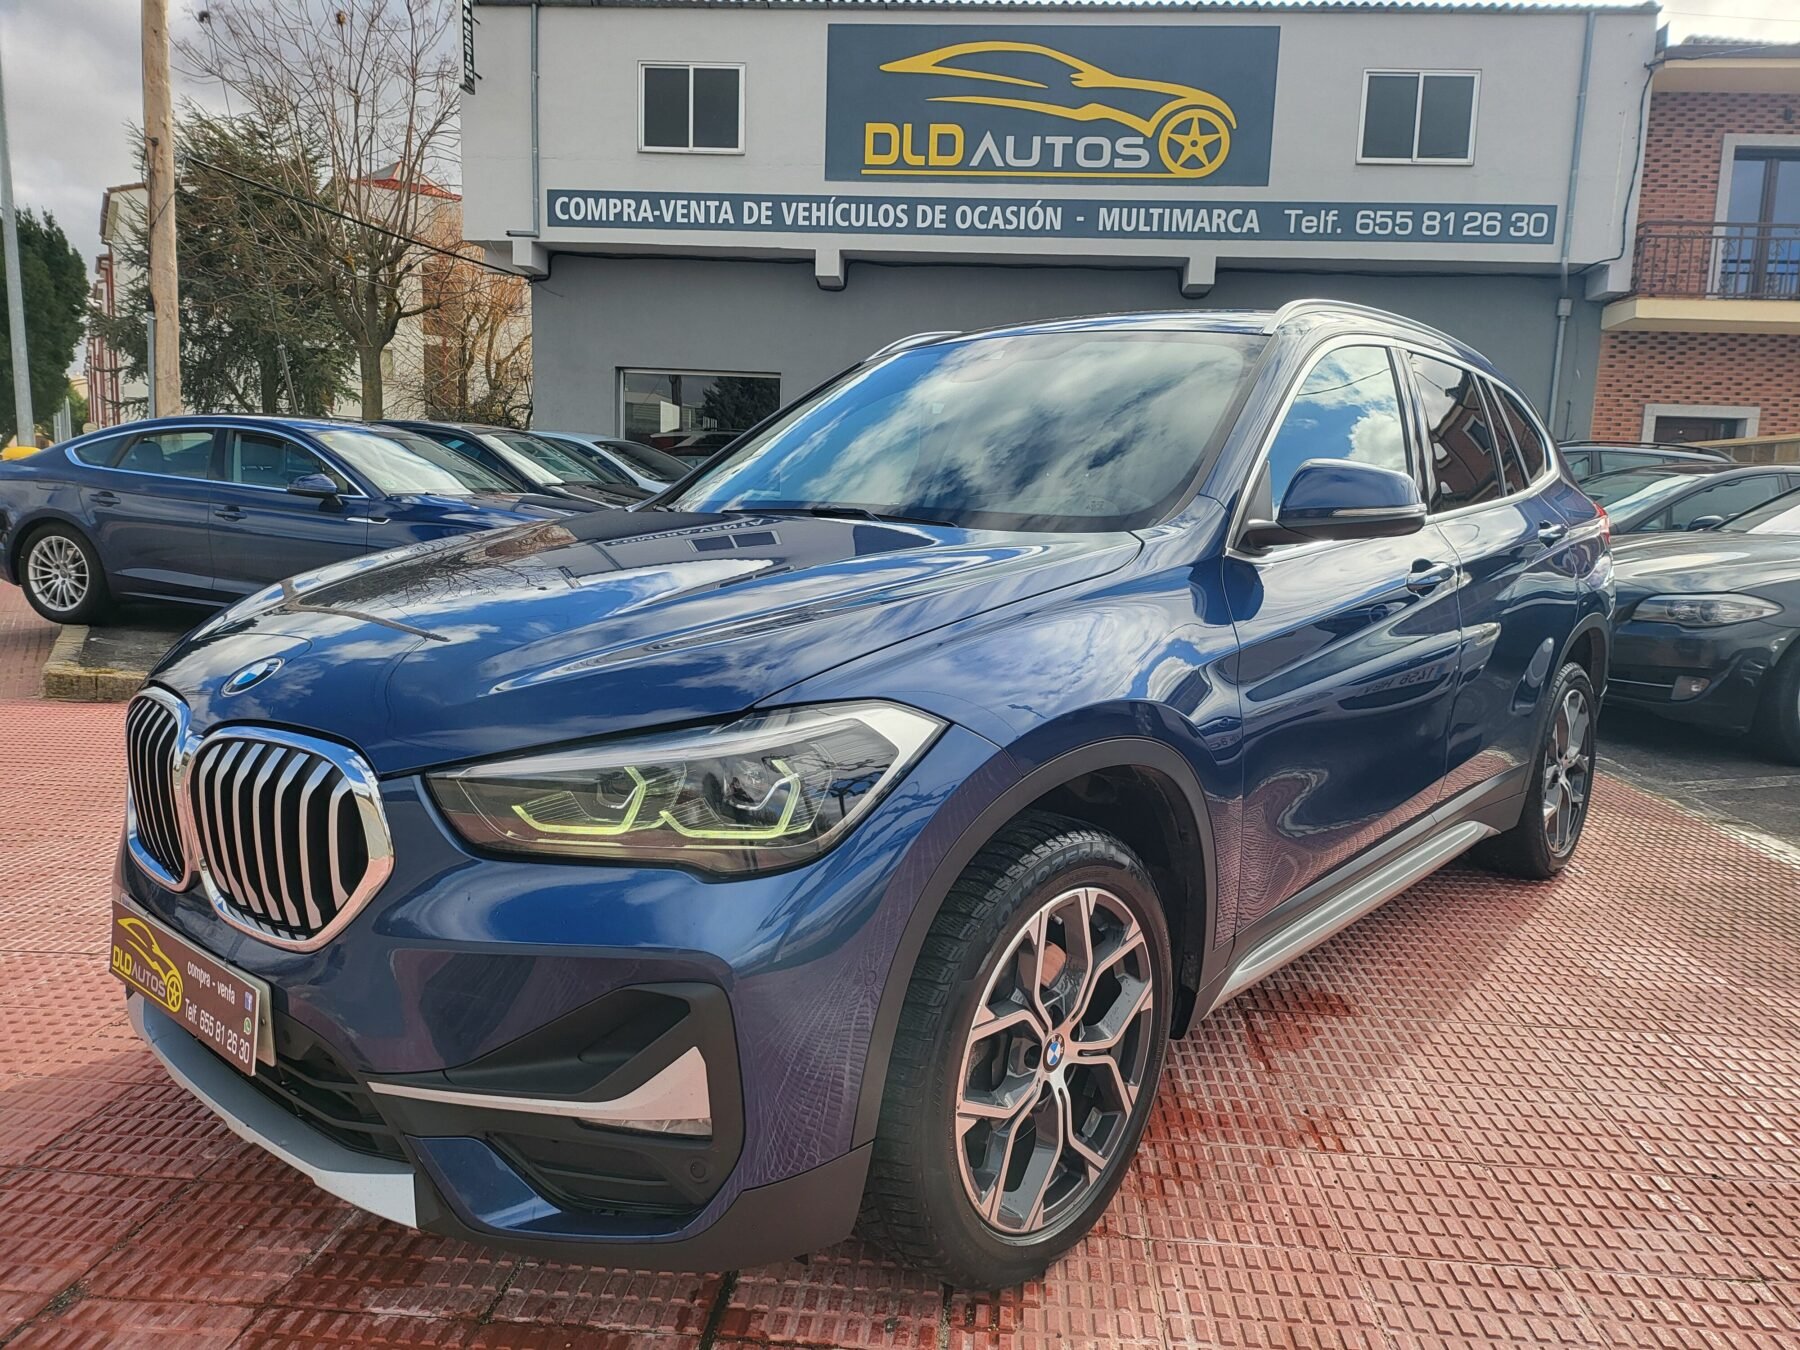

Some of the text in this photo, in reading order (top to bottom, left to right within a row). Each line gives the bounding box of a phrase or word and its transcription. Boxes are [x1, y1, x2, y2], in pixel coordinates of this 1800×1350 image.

[864, 122, 1150, 169] DLD AUTOS
[554, 196, 734, 224] COMPRA-VENTA
[743, 201, 773, 225] DE
[781, 197, 908, 228] VEHÍCULOS
[916, 205, 947, 229] DE
[954, 200, 1062, 230] OCASIÓN
[1098, 208, 1260, 233] MULTIMARCA
[1284, 210, 1342, 234] Telf.
[1355, 210, 1413, 235] 655
[1422, 211, 1455, 236] 81
[1462, 212, 1502, 236] 26
[1509, 212, 1548, 237] 30
[112, 945, 166, 998] DLD AUTOS
[188, 961, 210, 988] compra
[218, 980, 236, 1005] venta
[185, 998, 250, 1064] Telf. 655 81 26 30
